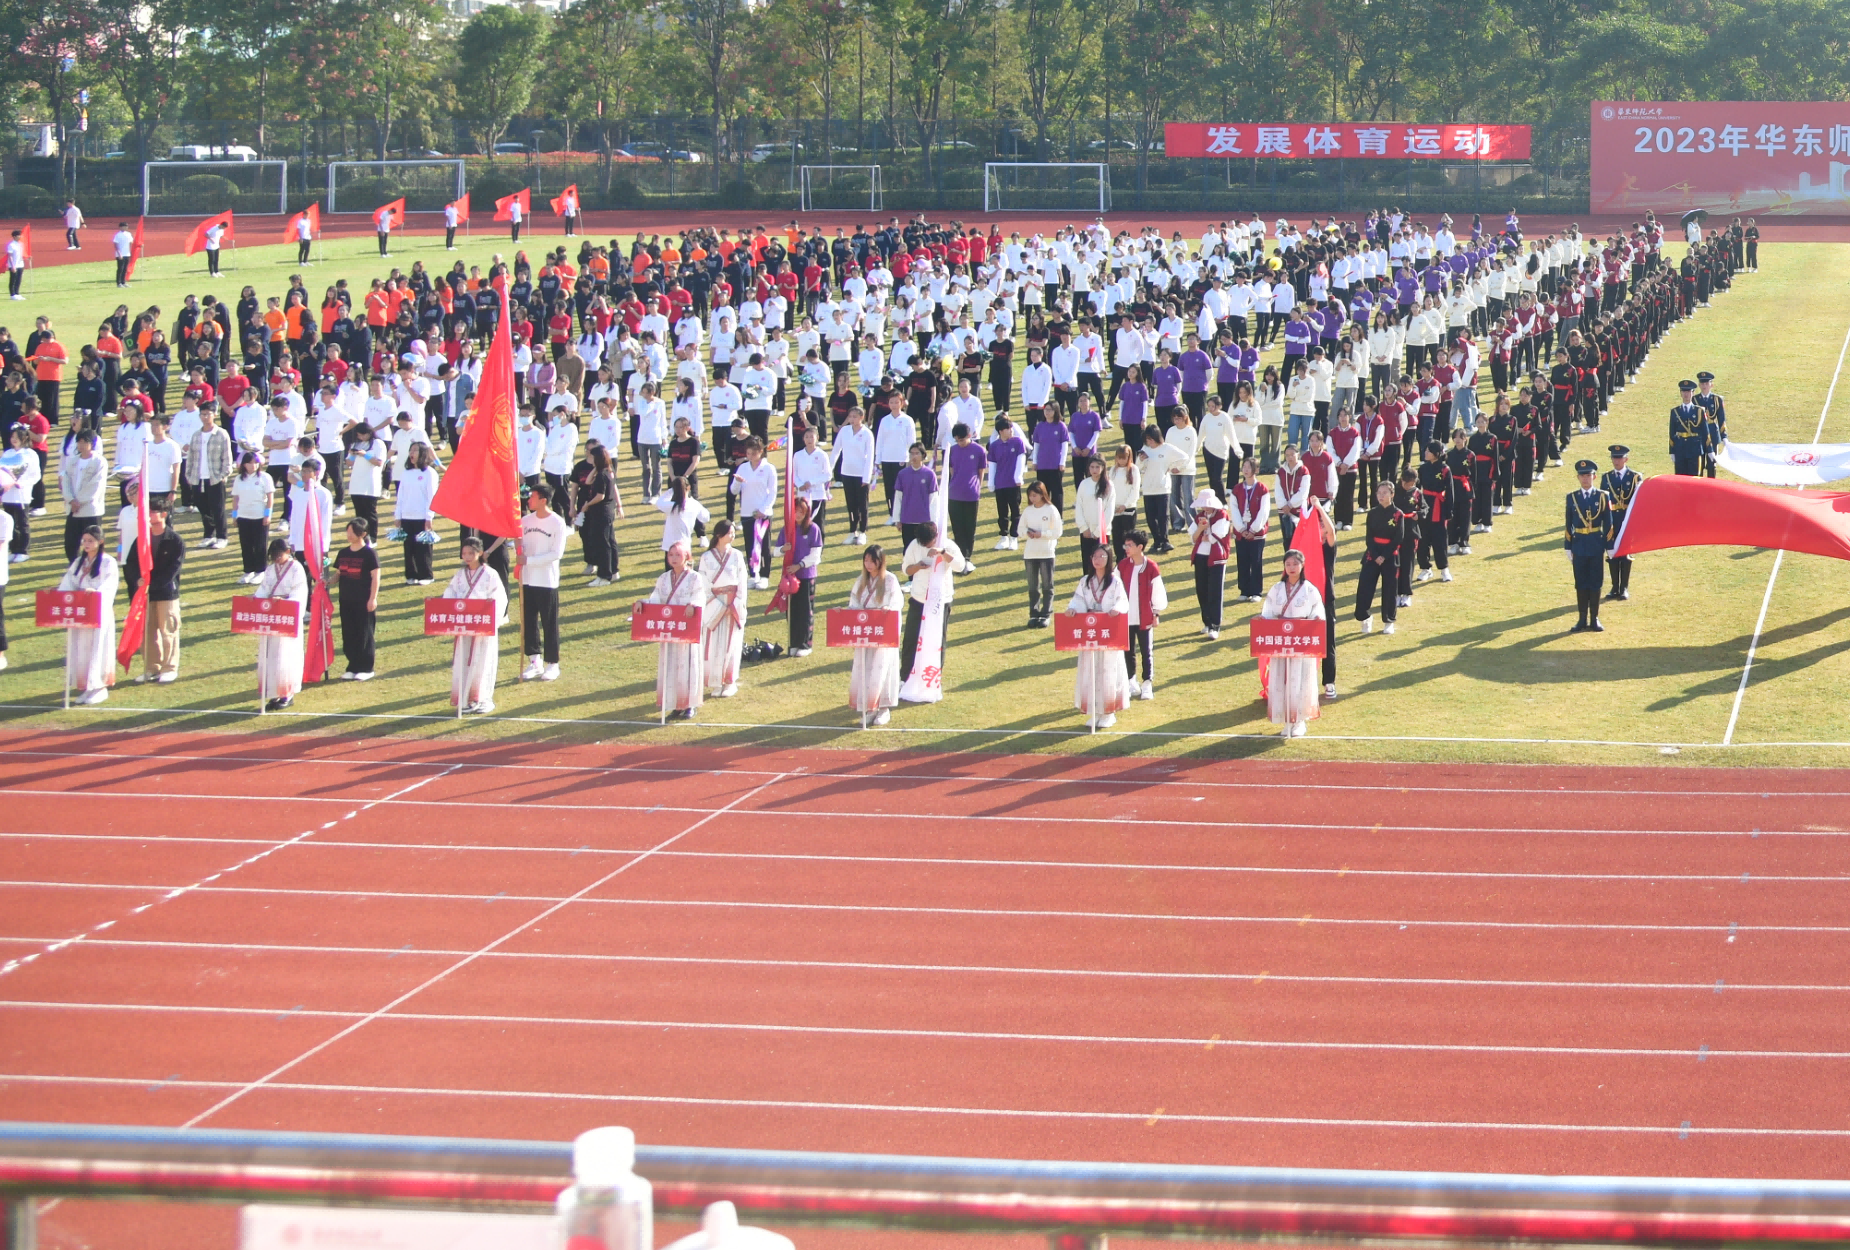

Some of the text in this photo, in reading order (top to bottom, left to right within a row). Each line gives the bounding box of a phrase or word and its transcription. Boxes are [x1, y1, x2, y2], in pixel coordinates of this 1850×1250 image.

[1206, 126, 1490, 155] 发展体育运动
[52, 606, 86, 616] 法学院
[236, 611, 294, 625] 政治与国际关系学院
[430, 613, 491, 624] 体育与健康学院
[646, 619, 687, 630] 教育学部
[841, 625, 884, 636] 传播学院
[1073, 628, 1111, 639] 哲学系
[1256, 635, 1320, 646] 中国语言文学系
